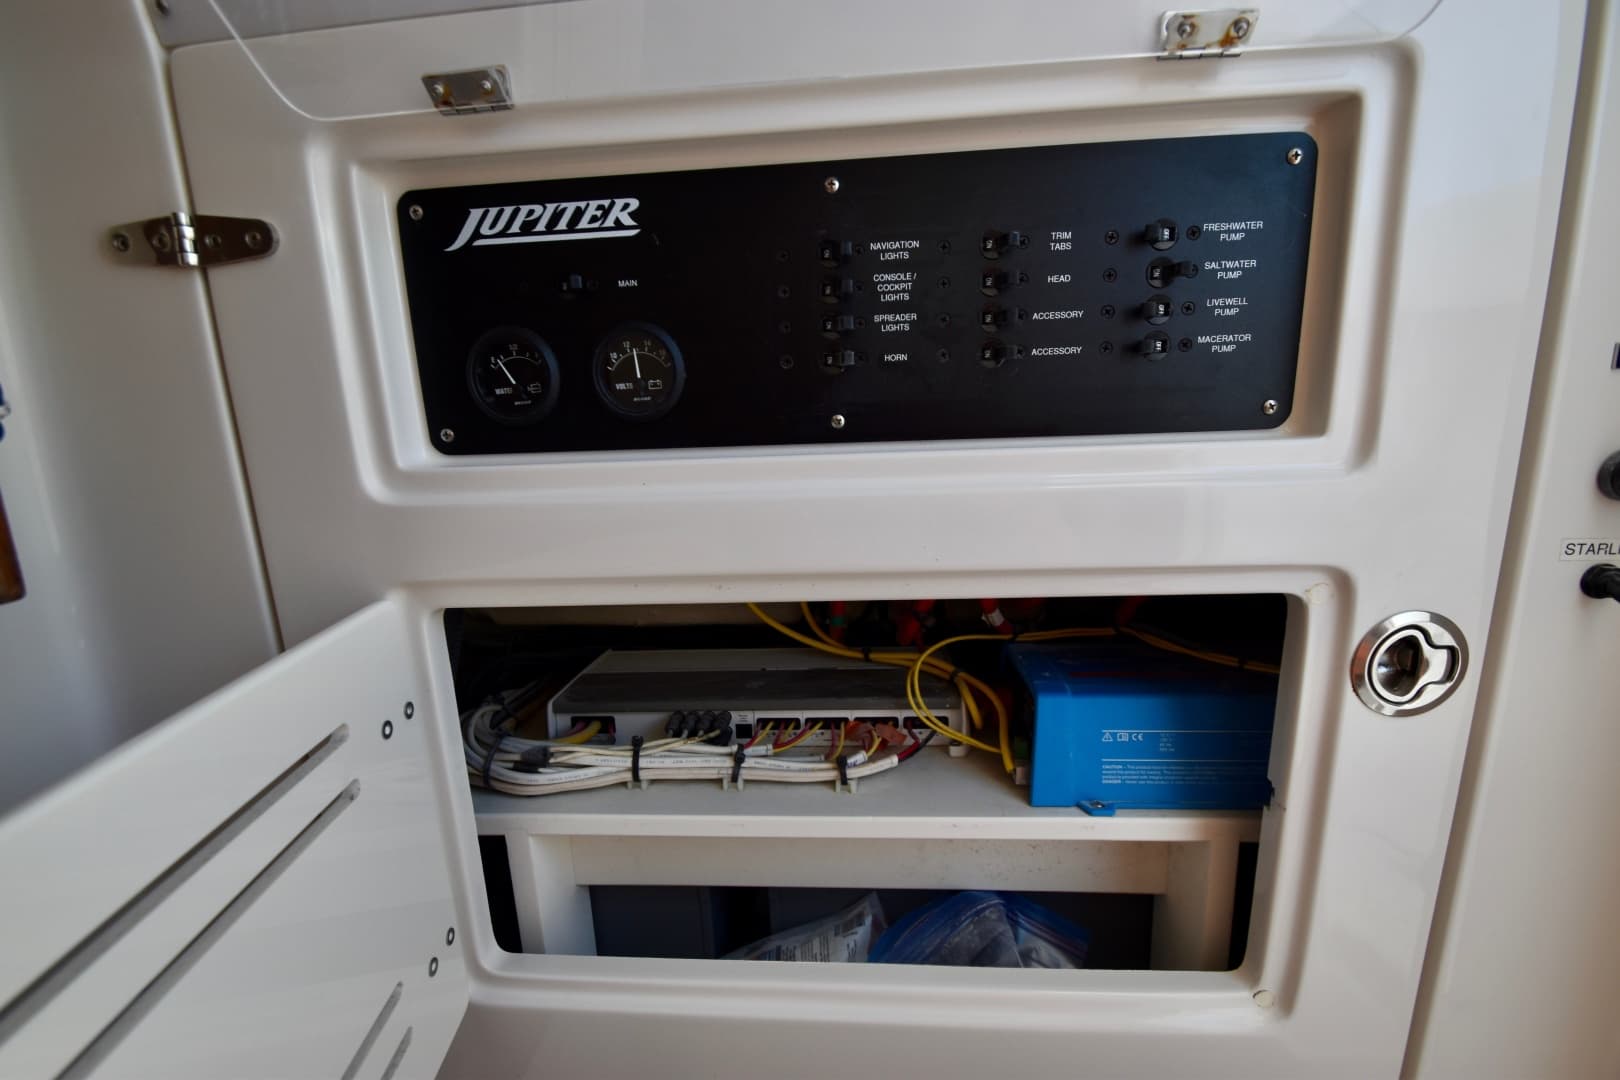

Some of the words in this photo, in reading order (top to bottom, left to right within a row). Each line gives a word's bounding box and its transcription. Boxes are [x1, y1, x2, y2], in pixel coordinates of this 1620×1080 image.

[444, 198, 640, 251] JUPITER
[1203, 220, 1264, 231] FRESHWATER
[1050, 232, 1072, 241] TRIM
[1219, 232, 1246, 242] PUMP
[869, 240, 920, 251] NAVIGATION
[1049, 241, 1072, 251] TABS
[880, 251, 910, 261] LIGHTS
[1204, 260, 1257, 270] SALTWATER
[872, 273, 912, 282] CONSOLE
[1047, 274, 1071, 283] HEAD
[1217, 270, 1243, 280] PUMP
[617, 279, 638, 288] MAIN
[876, 282, 913, 292] COCKPIT
[880, 292, 910, 302] LIGHTS
[1206, 297, 1249, 307] LIVEWELL
[1032, 310, 1084, 320] ACCESSORY
[1214, 307, 1240, 317] PUMP
[873, 313, 918, 323] SPREADER
[881, 323, 910, 332] LIGHTS
[1197, 333, 1252, 344] MACERATOR
[1031, 346, 1083, 356] ACCESSORY
[1211, 344, 1237, 354] PUMP
[884, 353, 908, 362] HORN
